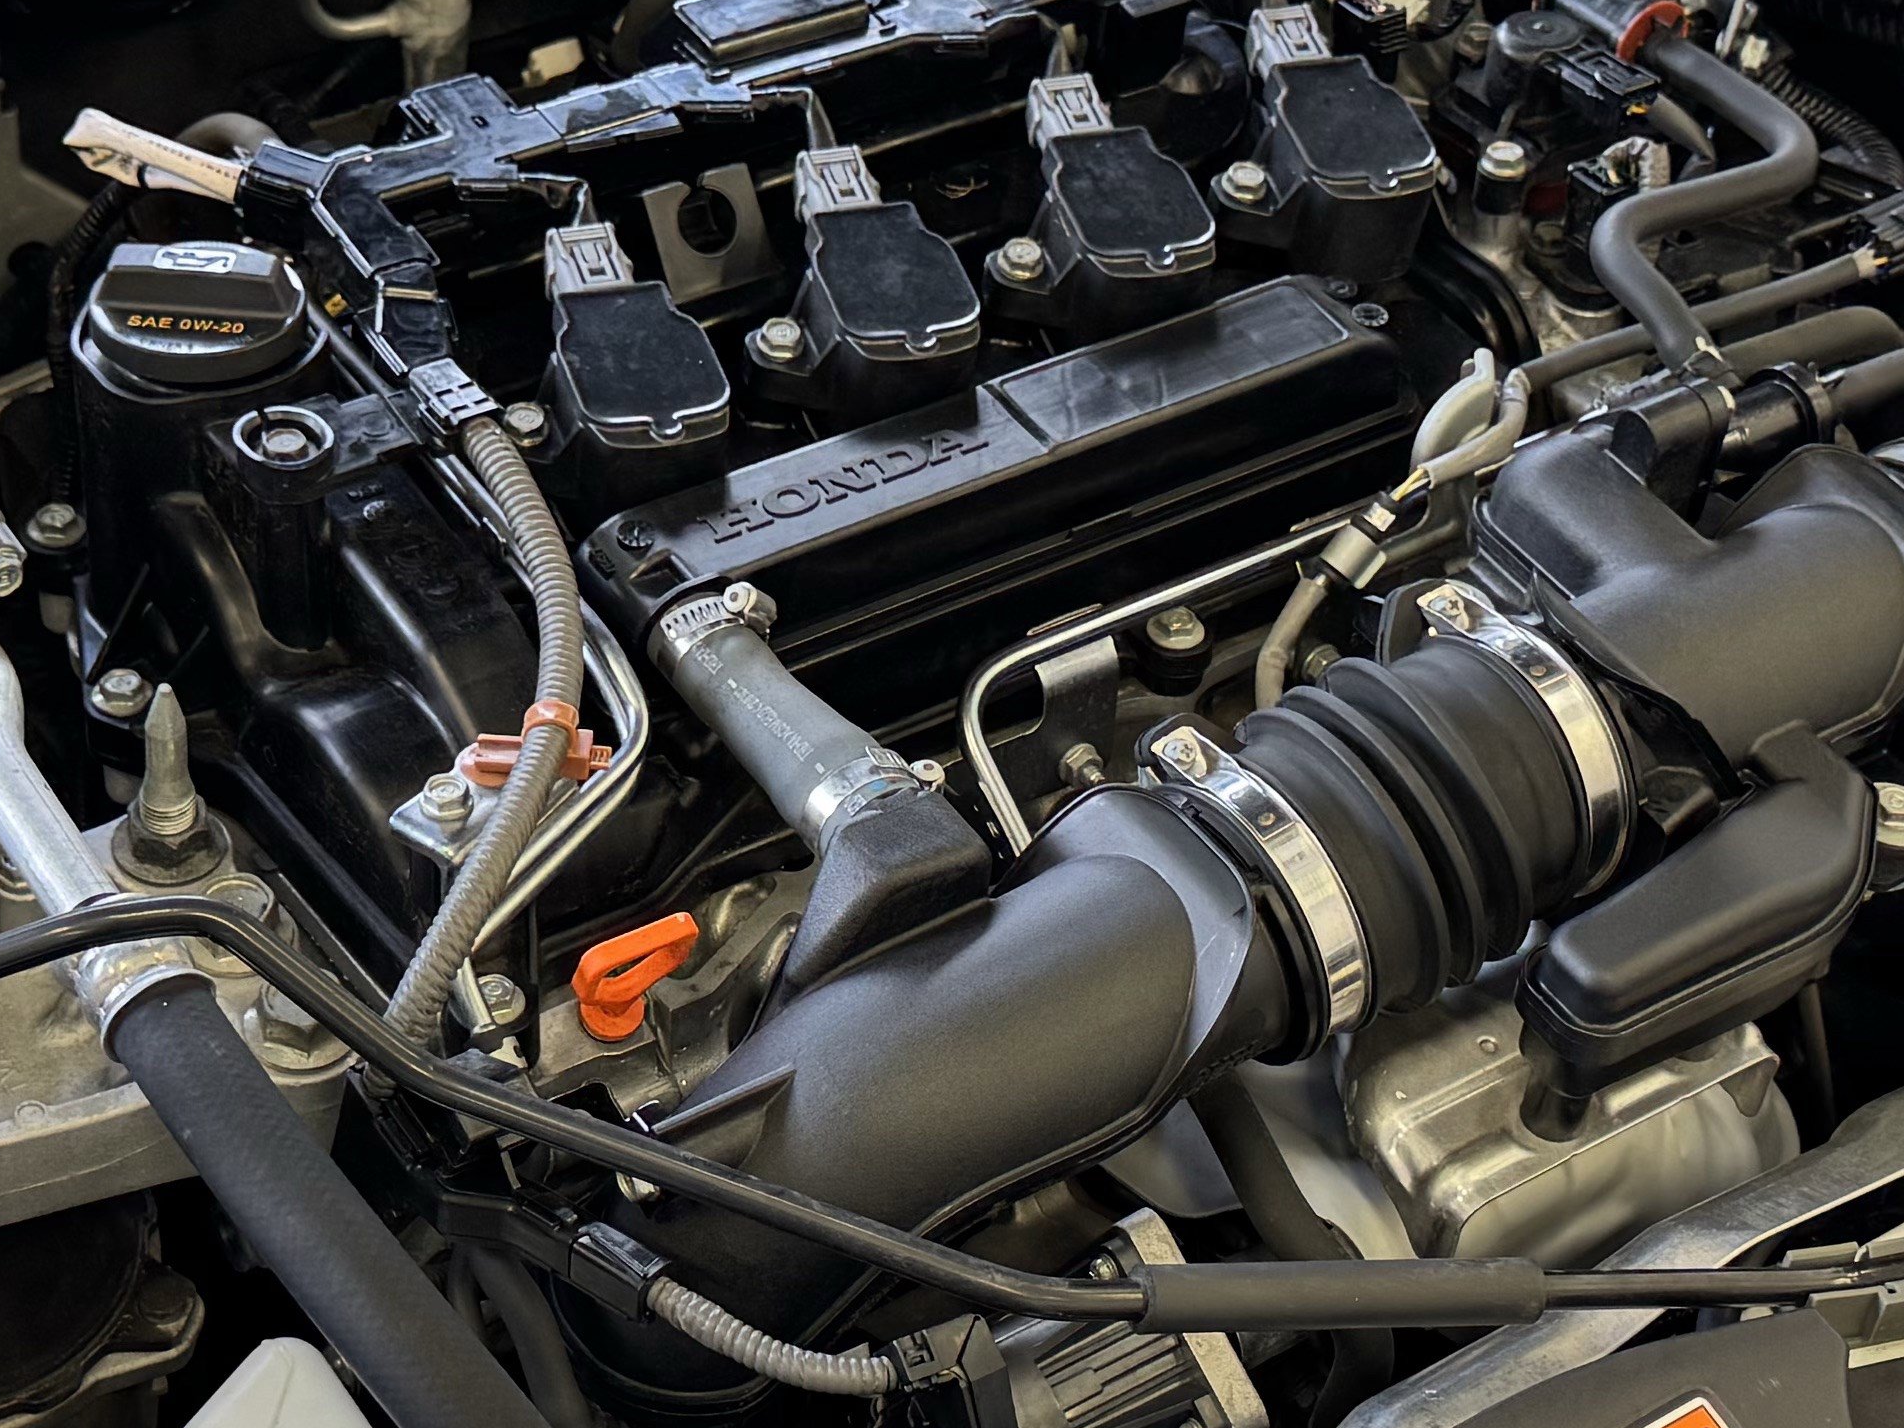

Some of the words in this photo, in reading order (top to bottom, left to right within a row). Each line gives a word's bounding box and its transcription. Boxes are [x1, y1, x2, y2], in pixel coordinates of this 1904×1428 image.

[127, 315, 174, 329] SAE
[179, 318, 245, 334] 0W-20
[696, 429, 991, 544] HONDA
